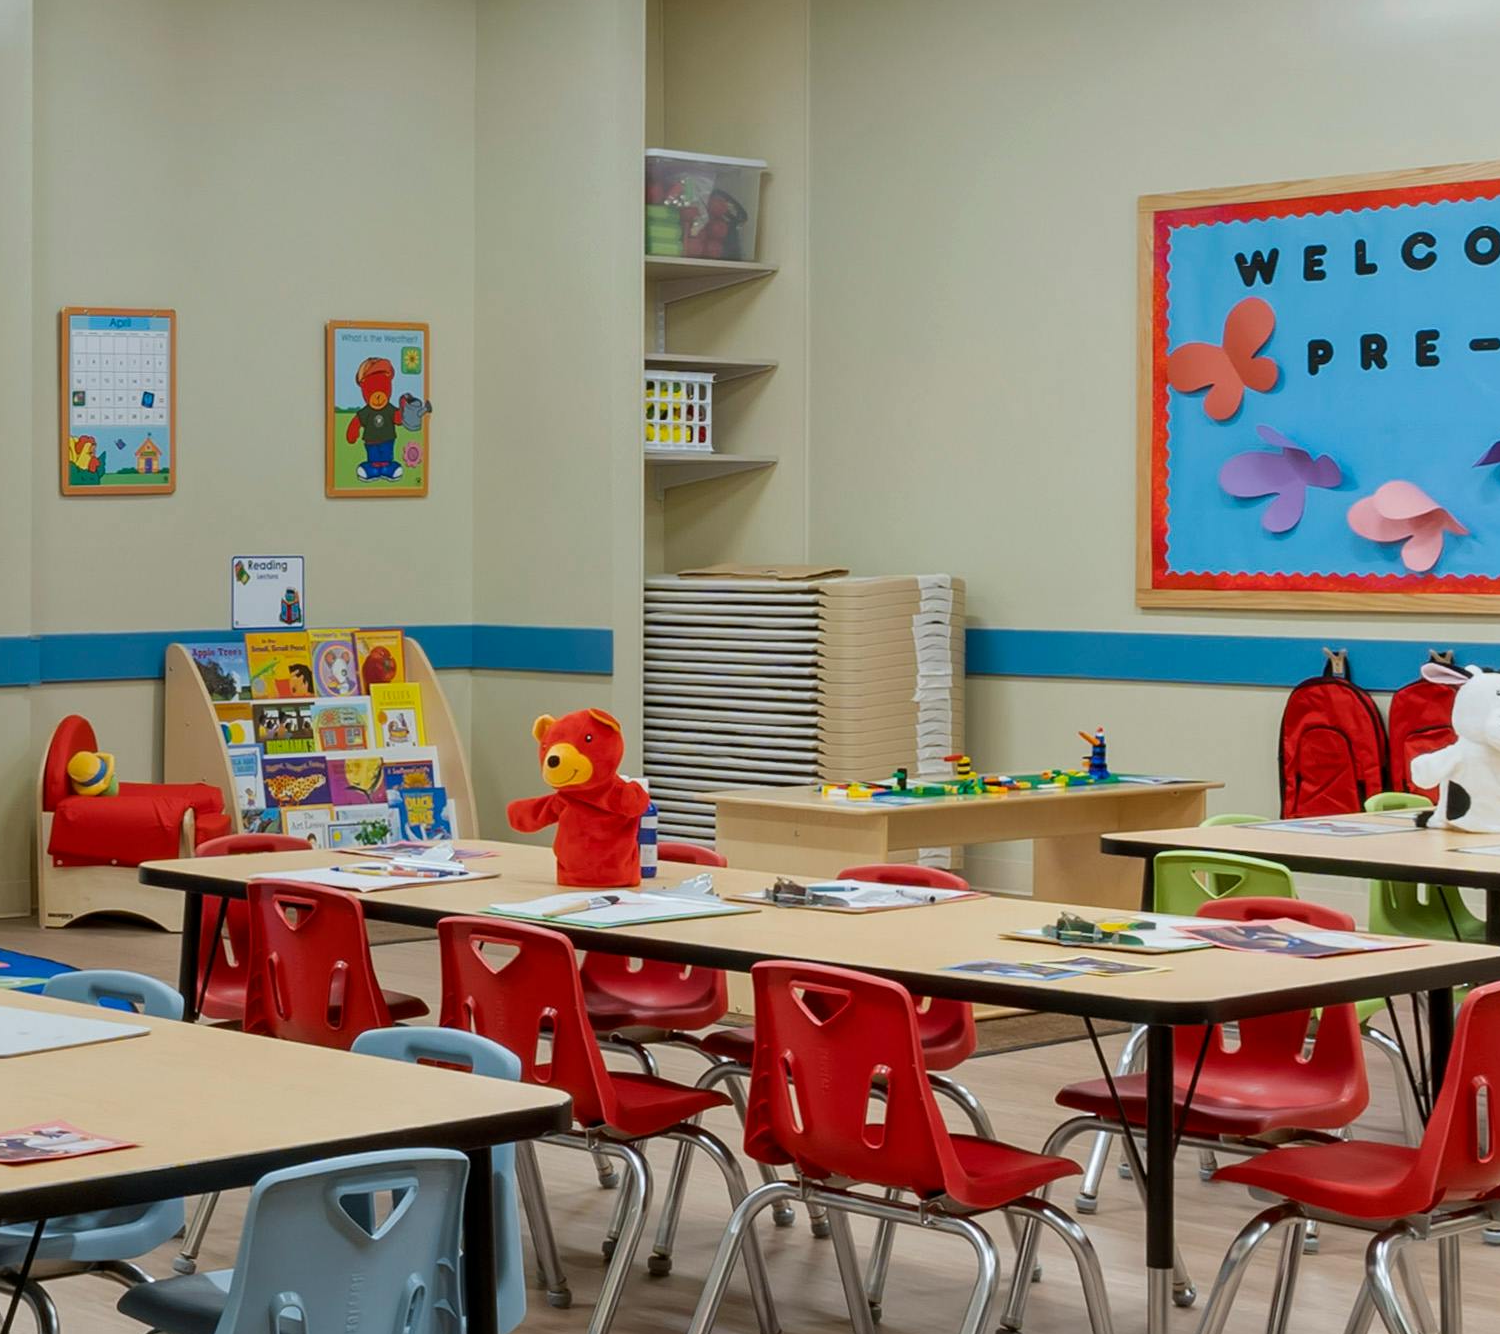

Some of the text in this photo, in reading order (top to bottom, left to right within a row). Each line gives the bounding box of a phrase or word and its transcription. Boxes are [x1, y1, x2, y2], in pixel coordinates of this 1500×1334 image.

[109, 318, 131, 328] April
[248, 560, 288, 572] Reading
[192, 647, 216, 660] Apple
